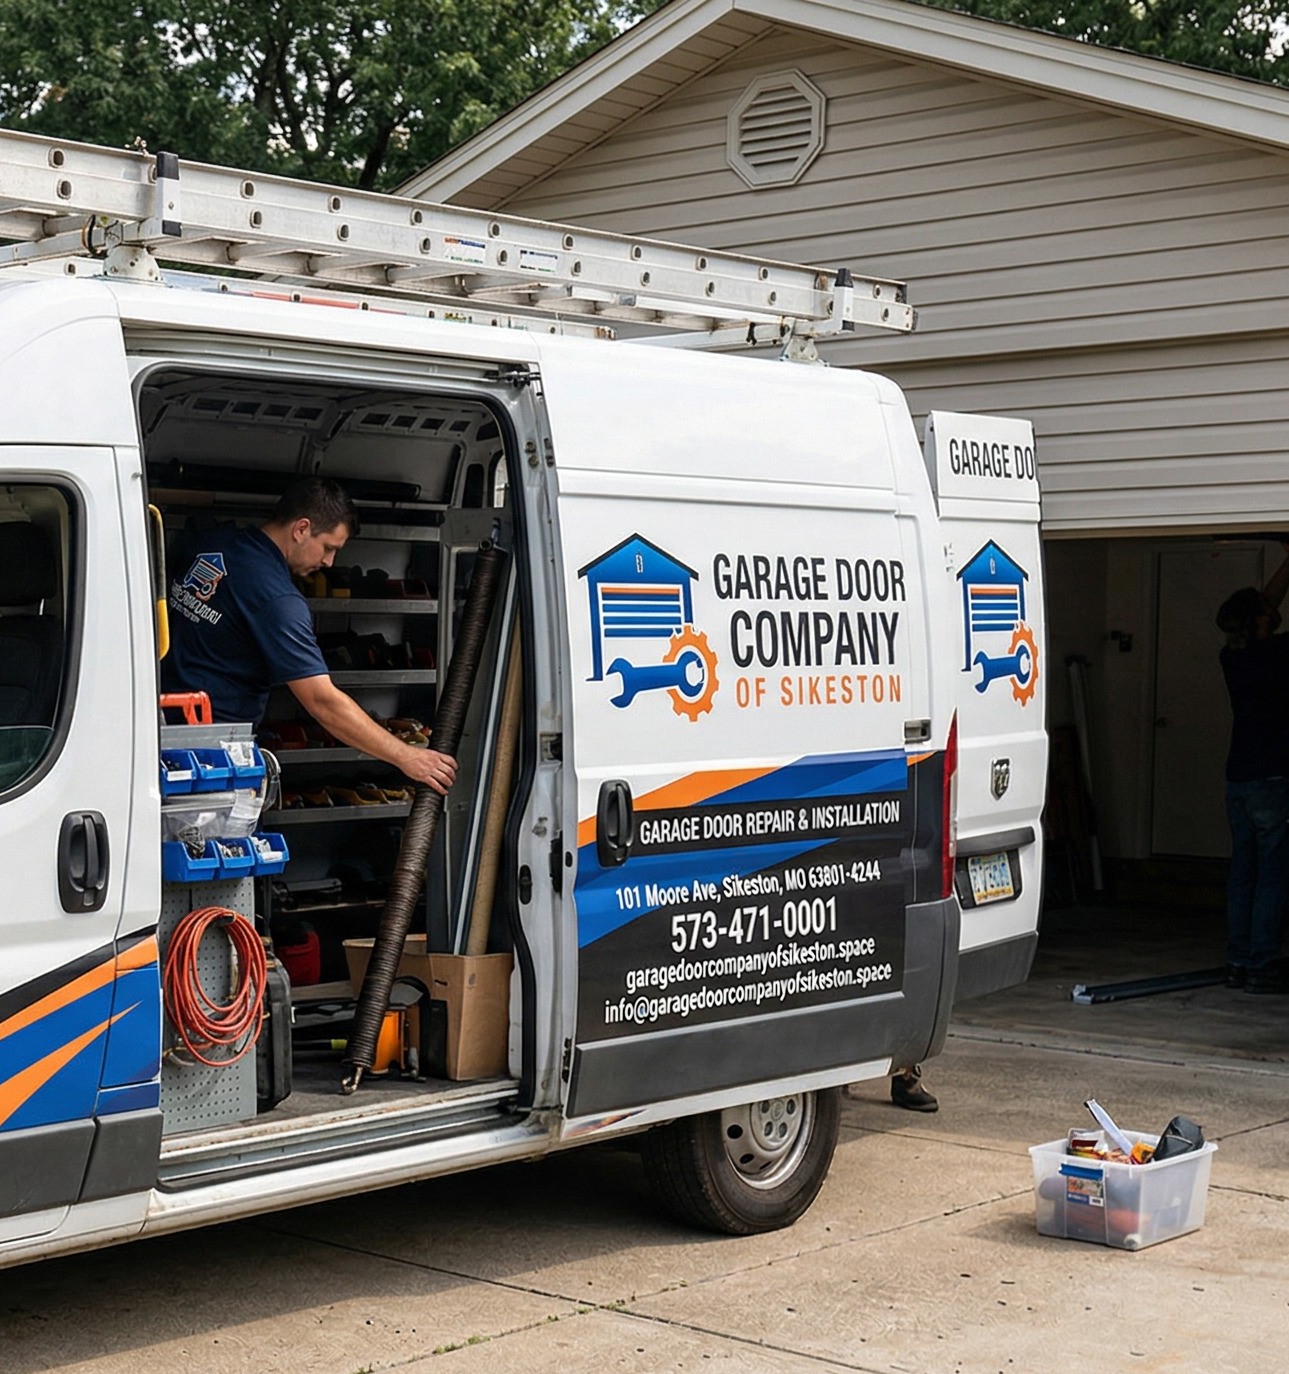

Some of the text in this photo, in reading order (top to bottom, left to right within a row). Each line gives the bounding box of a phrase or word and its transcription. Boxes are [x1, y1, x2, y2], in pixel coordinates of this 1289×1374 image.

[949, 438, 1012, 478] GARAGE
[713, 553, 906, 601] GARAGE DOOR
[730, 610, 899, 668] COMPANY
[736, 674, 901, 708] OF SIKESTON
[640, 801, 900, 845] GARAGE DOOR REPAIR & INSTALLATION
[615, 859, 881, 910] 101 Moore Ave, Sikeston, MO 63801-4244
[671, 896, 837, 953] 573-471-0001
[626, 937, 876, 994] garagedoorcompanyofsikeston.space
[605, 963, 892, 1024] info@garagedoorcompanyofsikeston.space
